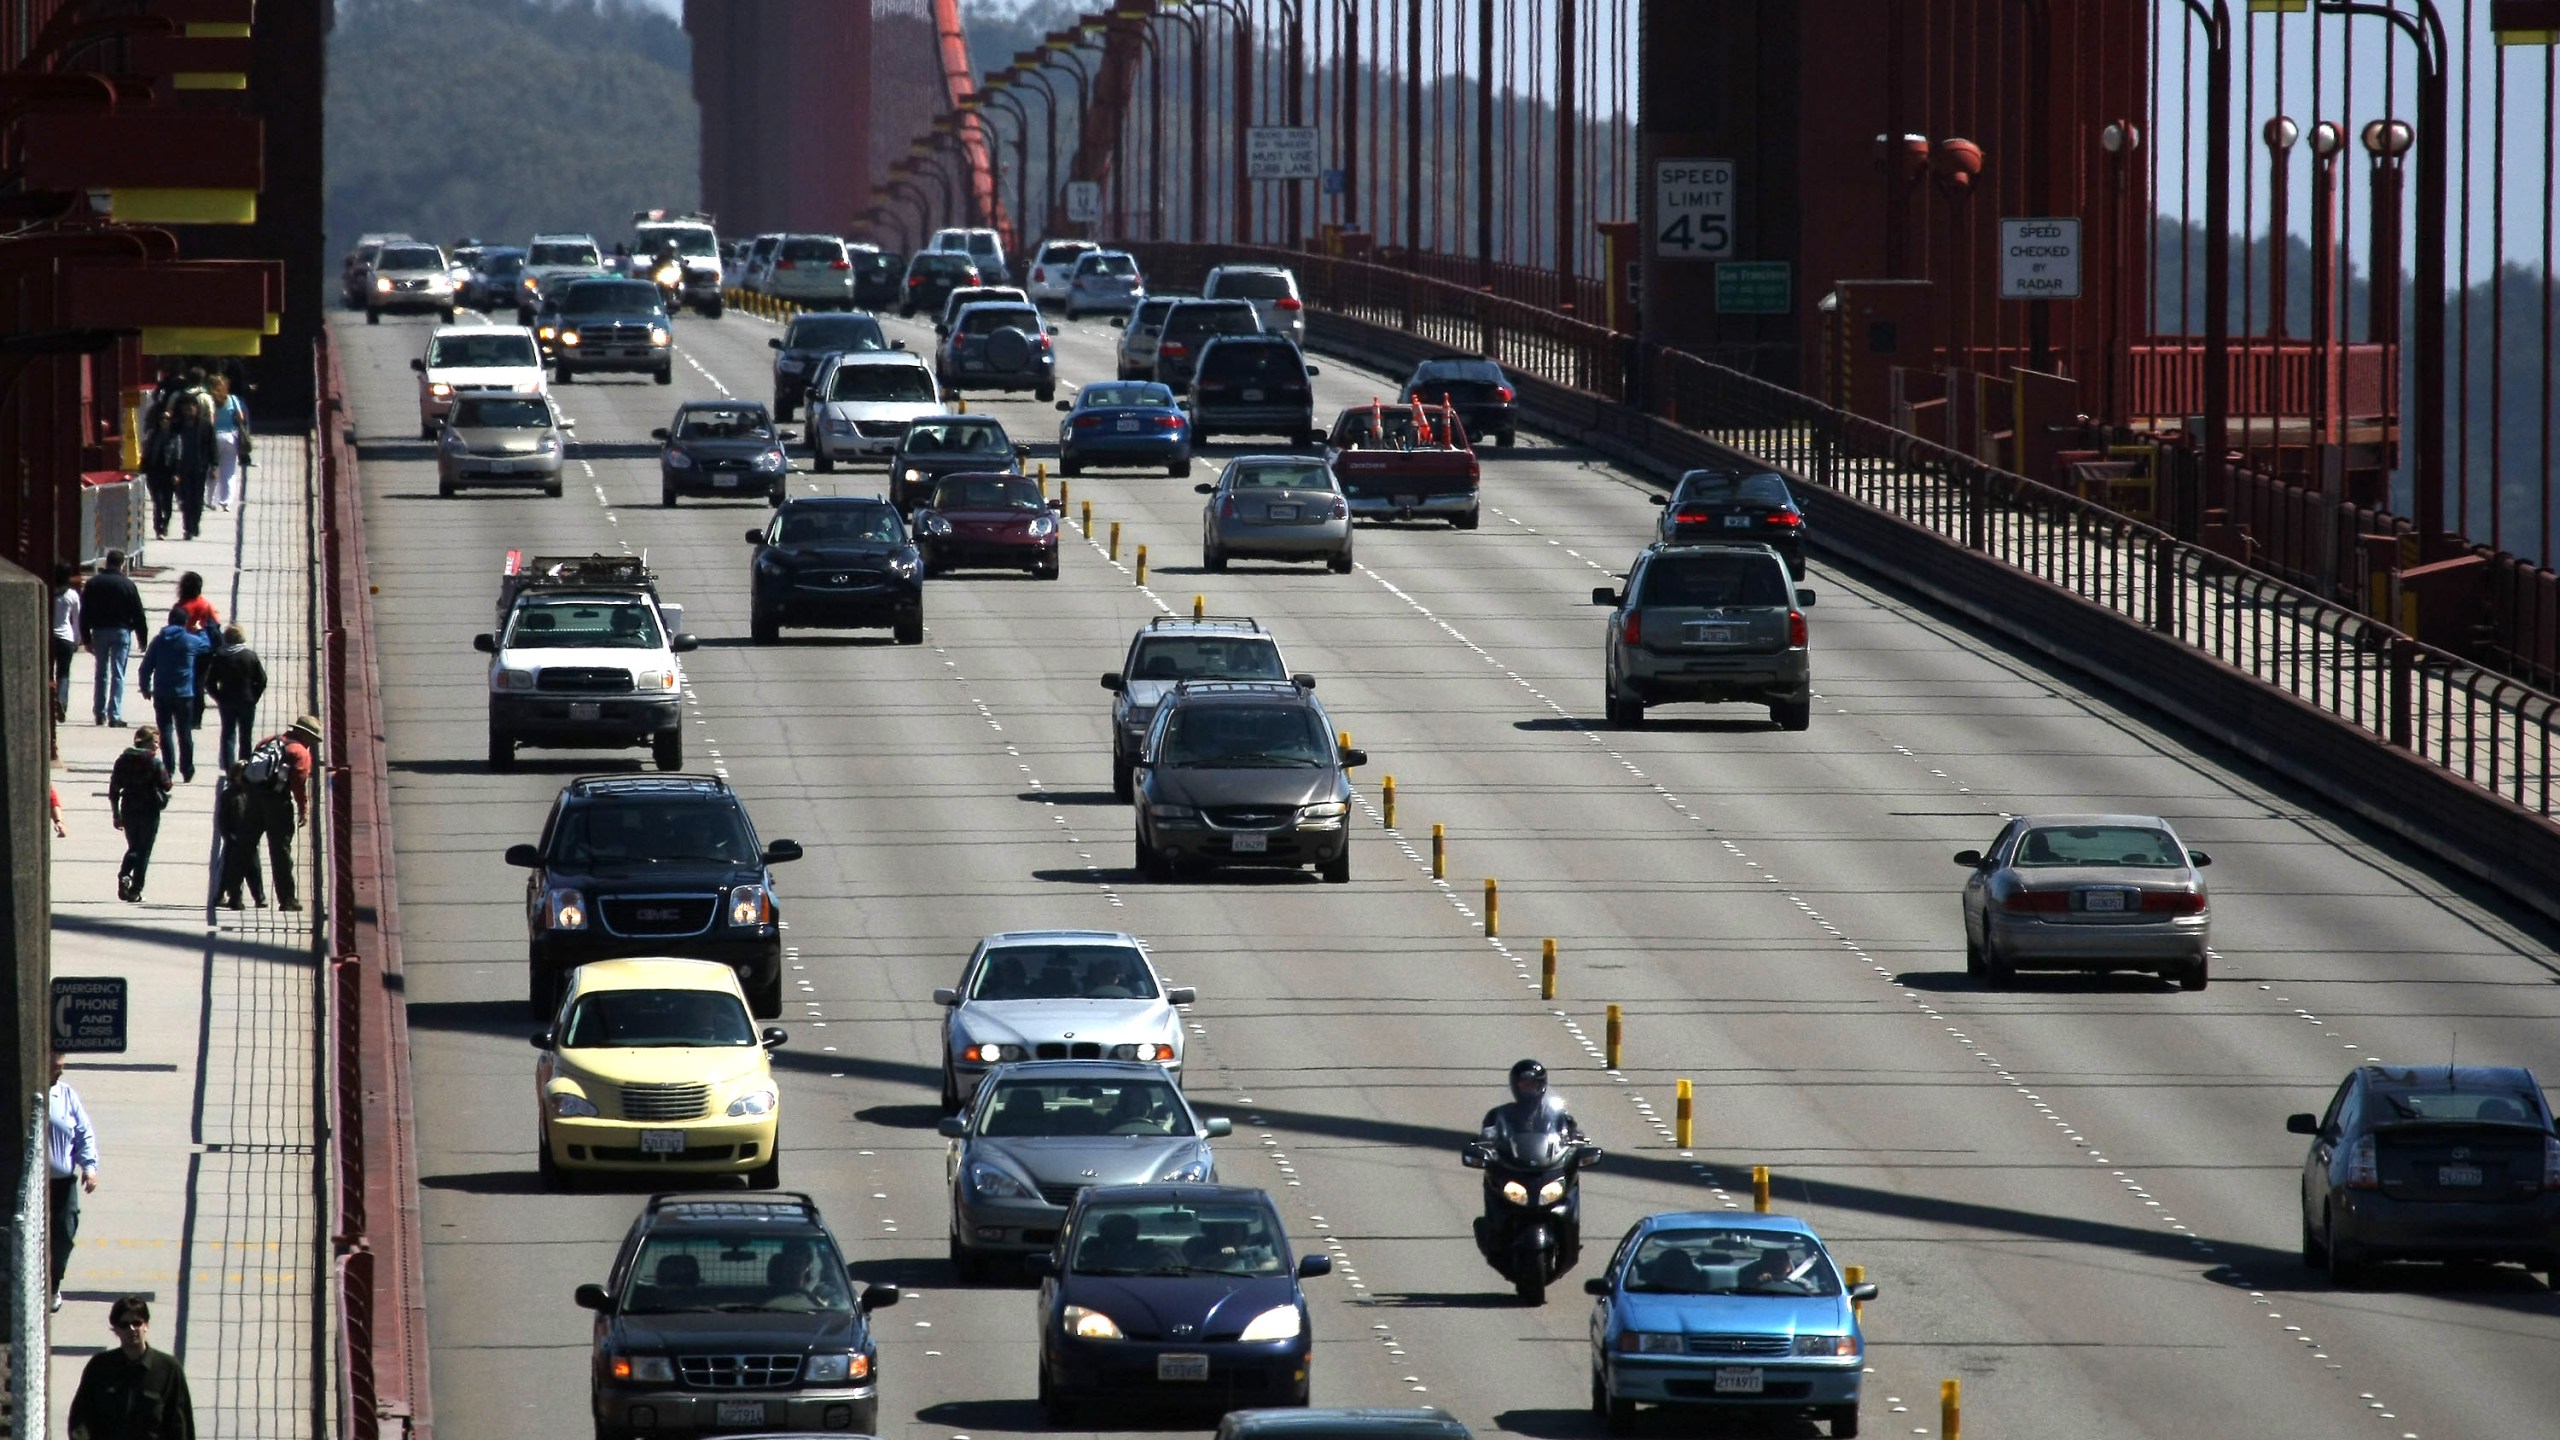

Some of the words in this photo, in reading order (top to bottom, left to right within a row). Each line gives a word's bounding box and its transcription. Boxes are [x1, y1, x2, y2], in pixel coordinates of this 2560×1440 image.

[1252, 152, 1283, 161] MUST
[1290, 151, 1313, 161] USE
[1285, 164, 1313, 174] LANE
[1661, 169, 1729, 184] SPEED
[1668, 191, 1724, 206] LIMIT
[1660, 214, 1729, 252] 45
[2020, 227, 2062, 238] SPEED
[2010, 246, 2070, 257] CHECKED
[2032, 263, 2047, 273] BY
[2017, 279, 2063, 289] RADAR
[1350, 462, 1387, 470] DODGE
[636, 908, 681, 921] GMC
[56, 983, 121, 994] EMERGENCY
[75, 999, 119, 1010] PHONE
[80, 1015, 113, 1024] AND
[78, 1026, 113, 1036] CRISIS
[55, 1038, 122, 1048] COUNSELING
